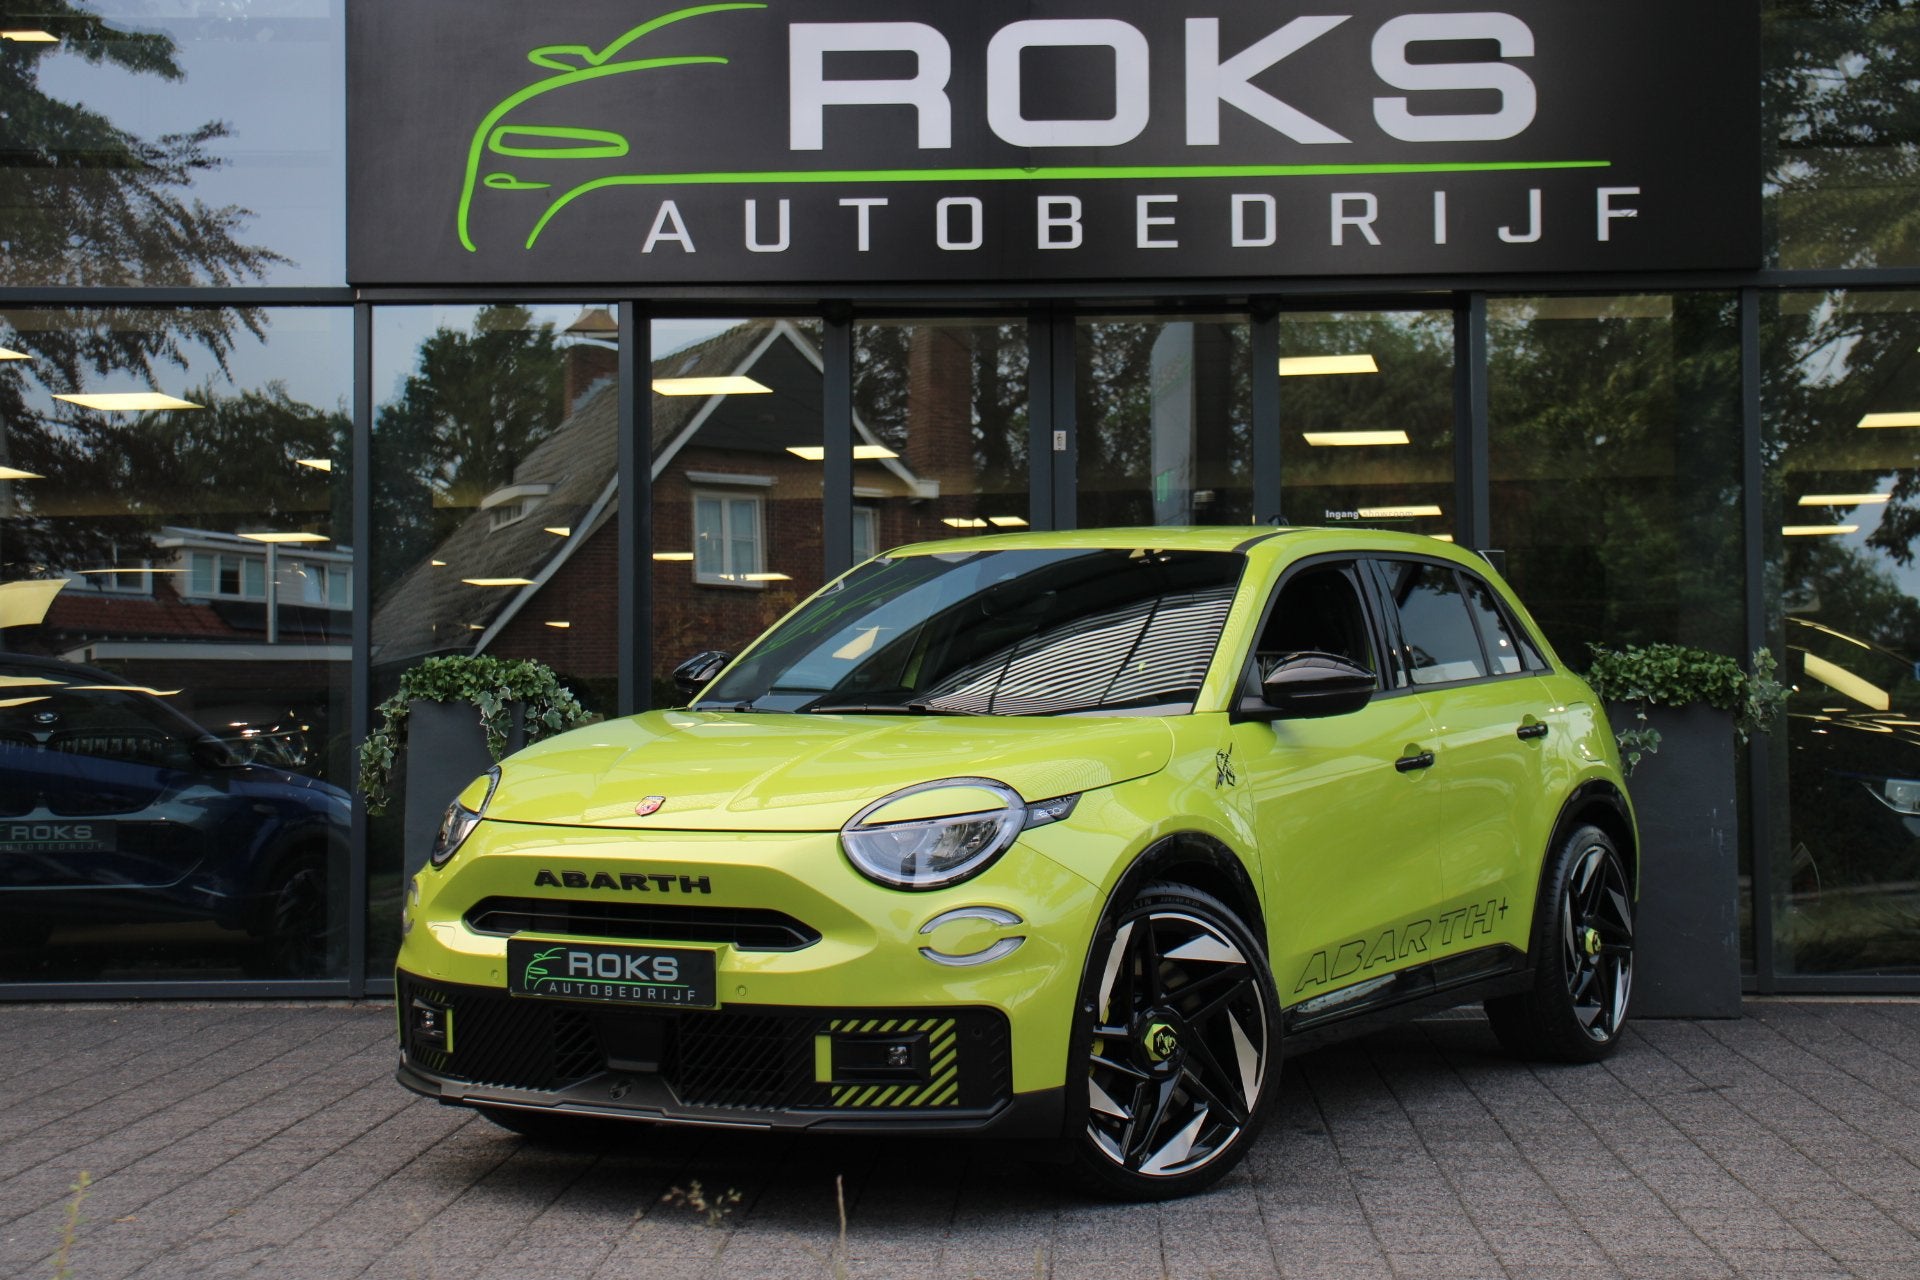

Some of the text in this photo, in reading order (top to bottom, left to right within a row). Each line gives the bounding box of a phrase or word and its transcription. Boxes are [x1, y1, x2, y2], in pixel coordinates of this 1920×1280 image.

[789, 12, 1537, 150] ROKS
[641, 187, 1641, 253] AUTOBEDRIJF
[1325, 509, 1359, 520] Ingang
[10, 825, 93, 840] ROKS
[0, 841, 105, 851] UTOBEDRIJF
[534, 869, 712, 894] ABARTH
[568, 951, 679, 982] ROKS
[549, 982, 696, 1001] AUTOBEDRIJF
